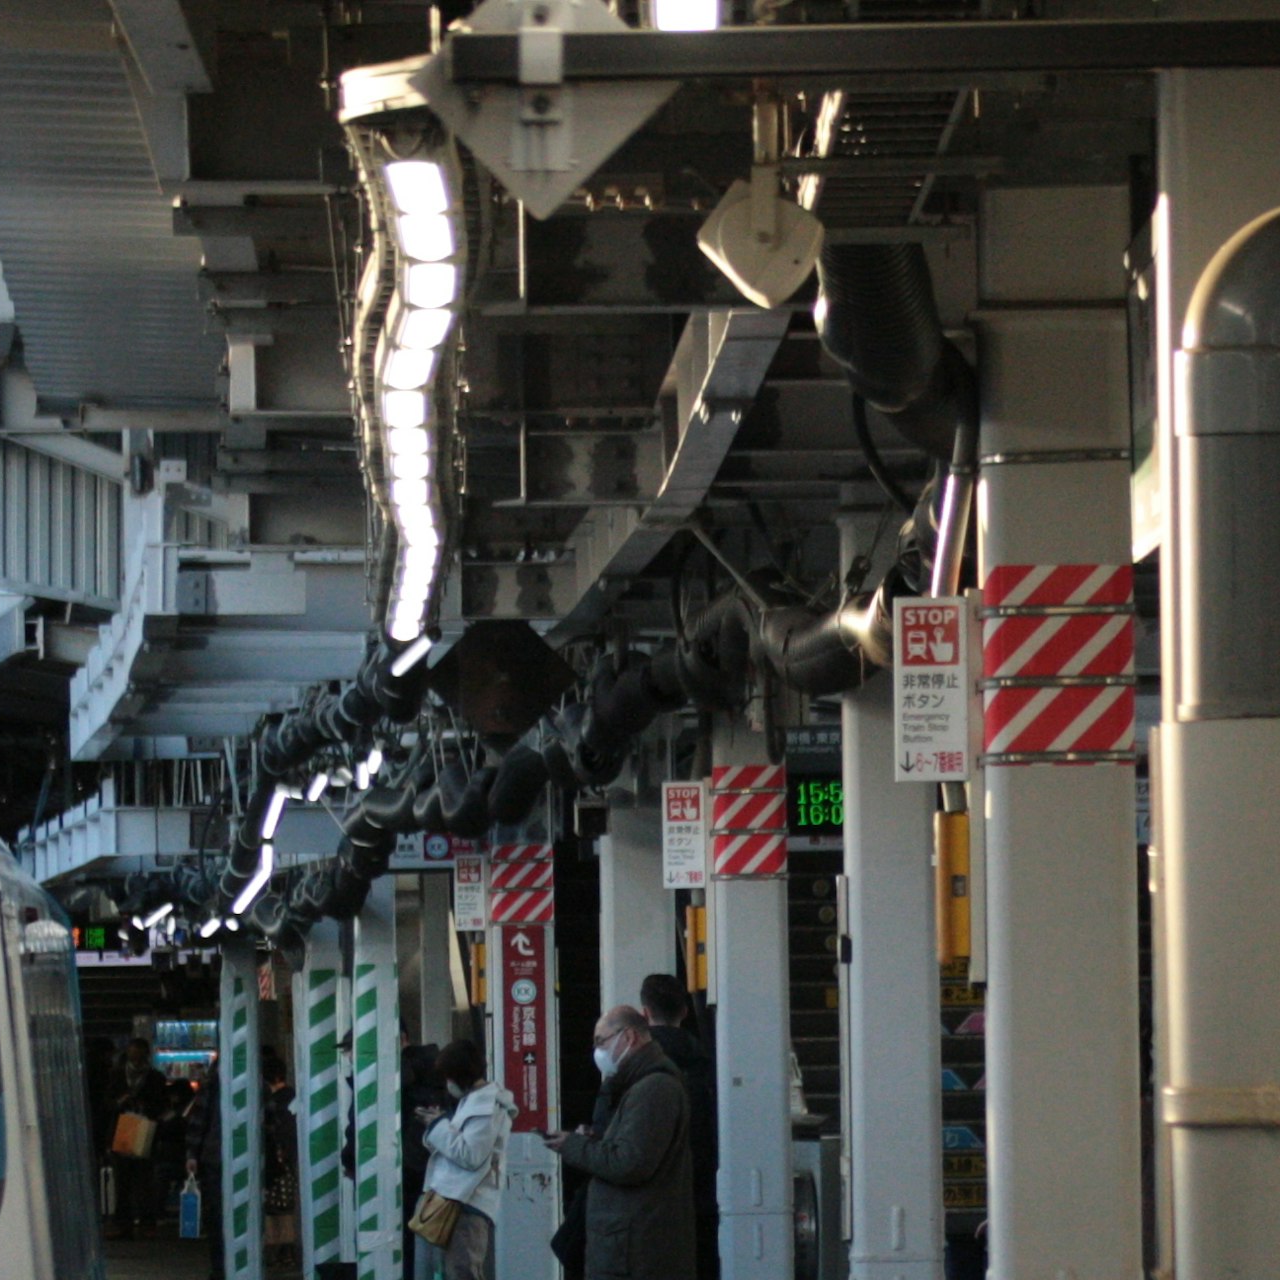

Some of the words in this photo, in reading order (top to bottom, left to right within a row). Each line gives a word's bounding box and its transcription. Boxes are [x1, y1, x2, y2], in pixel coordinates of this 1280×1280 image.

[905, 608, 955, 625] STOP
[902, 673, 959, 689] 非常停止
[902, 693, 945, 709] ボタン
[668, 789, 698, 799] STOP
[797, 783, 844, 804] 15:5
[797, 805, 845, 826] 16:0
